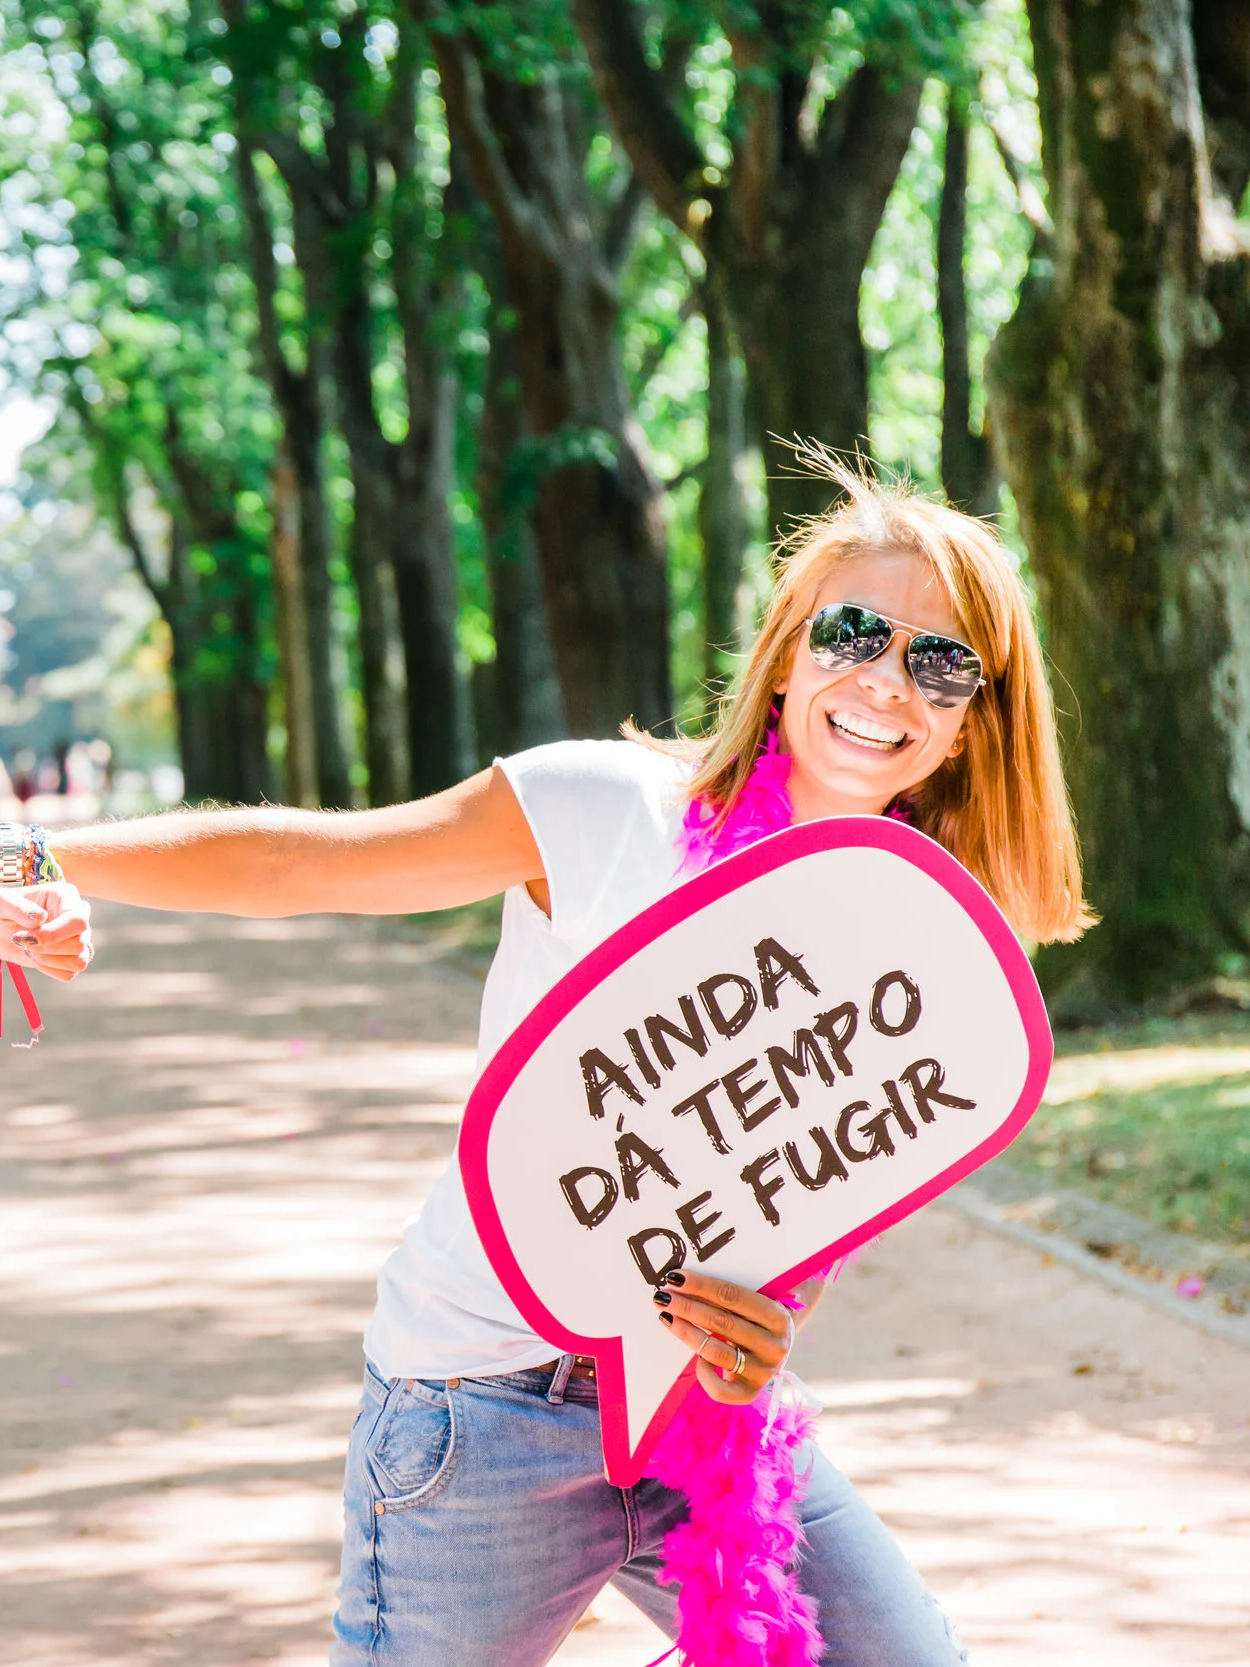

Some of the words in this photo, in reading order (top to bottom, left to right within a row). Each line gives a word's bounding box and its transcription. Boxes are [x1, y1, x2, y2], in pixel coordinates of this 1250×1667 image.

[559, 1113, 681, 1229] DÁ
[672, 969, 922, 1154] TEMPO
[580, 937, 821, 1119] AINDA
[627, 1190, 735, 1289] DE
[741, 1058, 977, 1226] FUGIR
